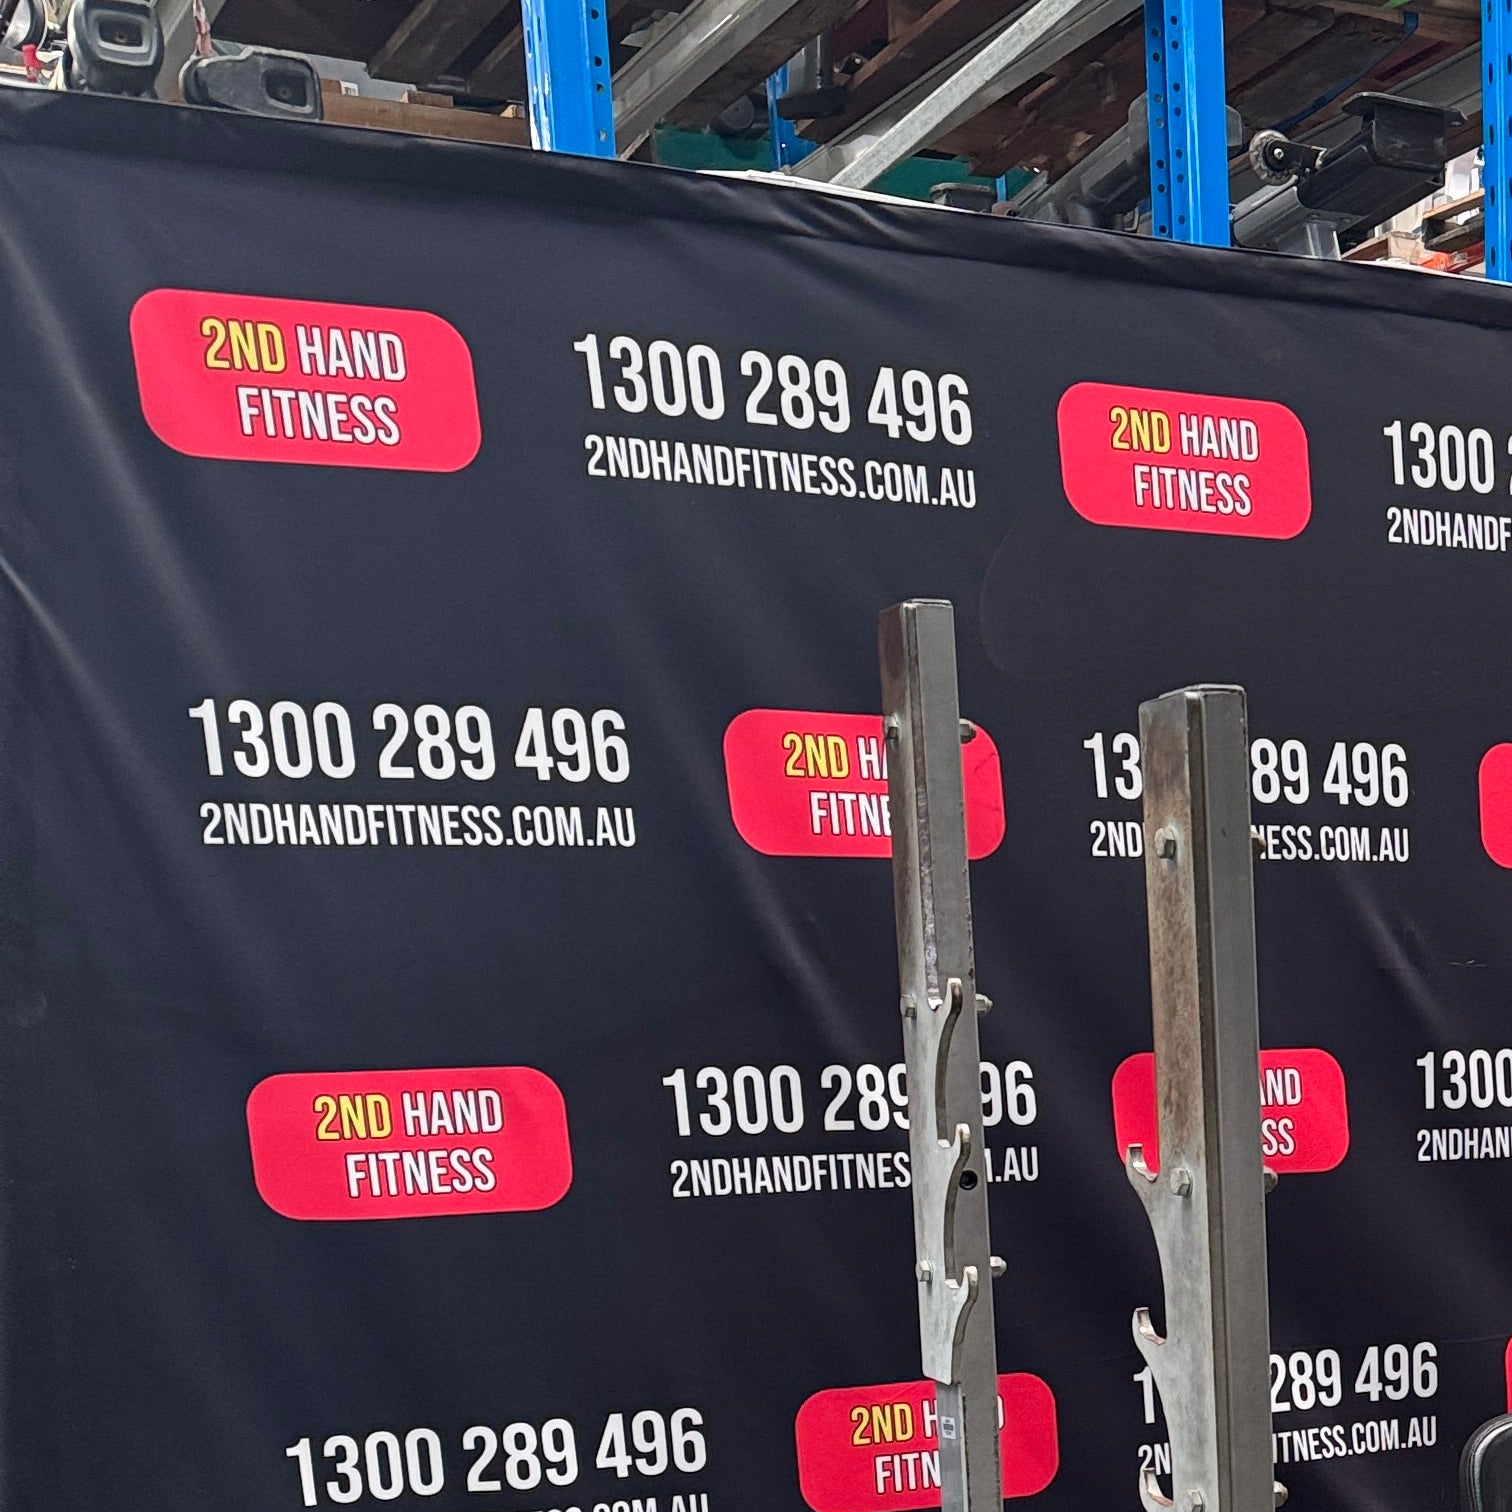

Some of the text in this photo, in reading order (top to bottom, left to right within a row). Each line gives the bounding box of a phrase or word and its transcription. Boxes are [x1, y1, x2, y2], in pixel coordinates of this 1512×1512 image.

[201, 318, 406, 381] 2ND HAND
[237, 386, 400, 446] FITNESS
[573, 333, 973, 446] 1300 289 496
[1110, 407, 1259, 461] 2ND HAND
[1383, 420, 1495, 494] 1300
[584, 434, 977, 509] 2NDHANDFITNESS.COM.AU
[1134, 464, 1251, 516] FITNESS
[188, 698, 630, 783] 1300 289 496
[783, 733, 849, 778] 2ND
[1083, 731, 1409, 808] 13 89 496
[199, 802, 636, 848] 2NDHANDFITNESS.COM.AU
[810, 791, 892, 837] FITNE
[314, 1089, 503, 1140] 2ND HAND
[662, 1064, 804, 1137] 1300
[979, 1060, 1037, 1128] 96
[346, 1147, 496, 1197] FITNESS
[670, 1144, 1039, 1199] 2NDHANDFITNES.AU
[1269, 1341, 1438, 1414] 289 496
[851, 1403, 913, 1445] 2ND
[285, 1407, 707, 1507] 1300 289 496
[875, 1448, 941, 1495] FITN
